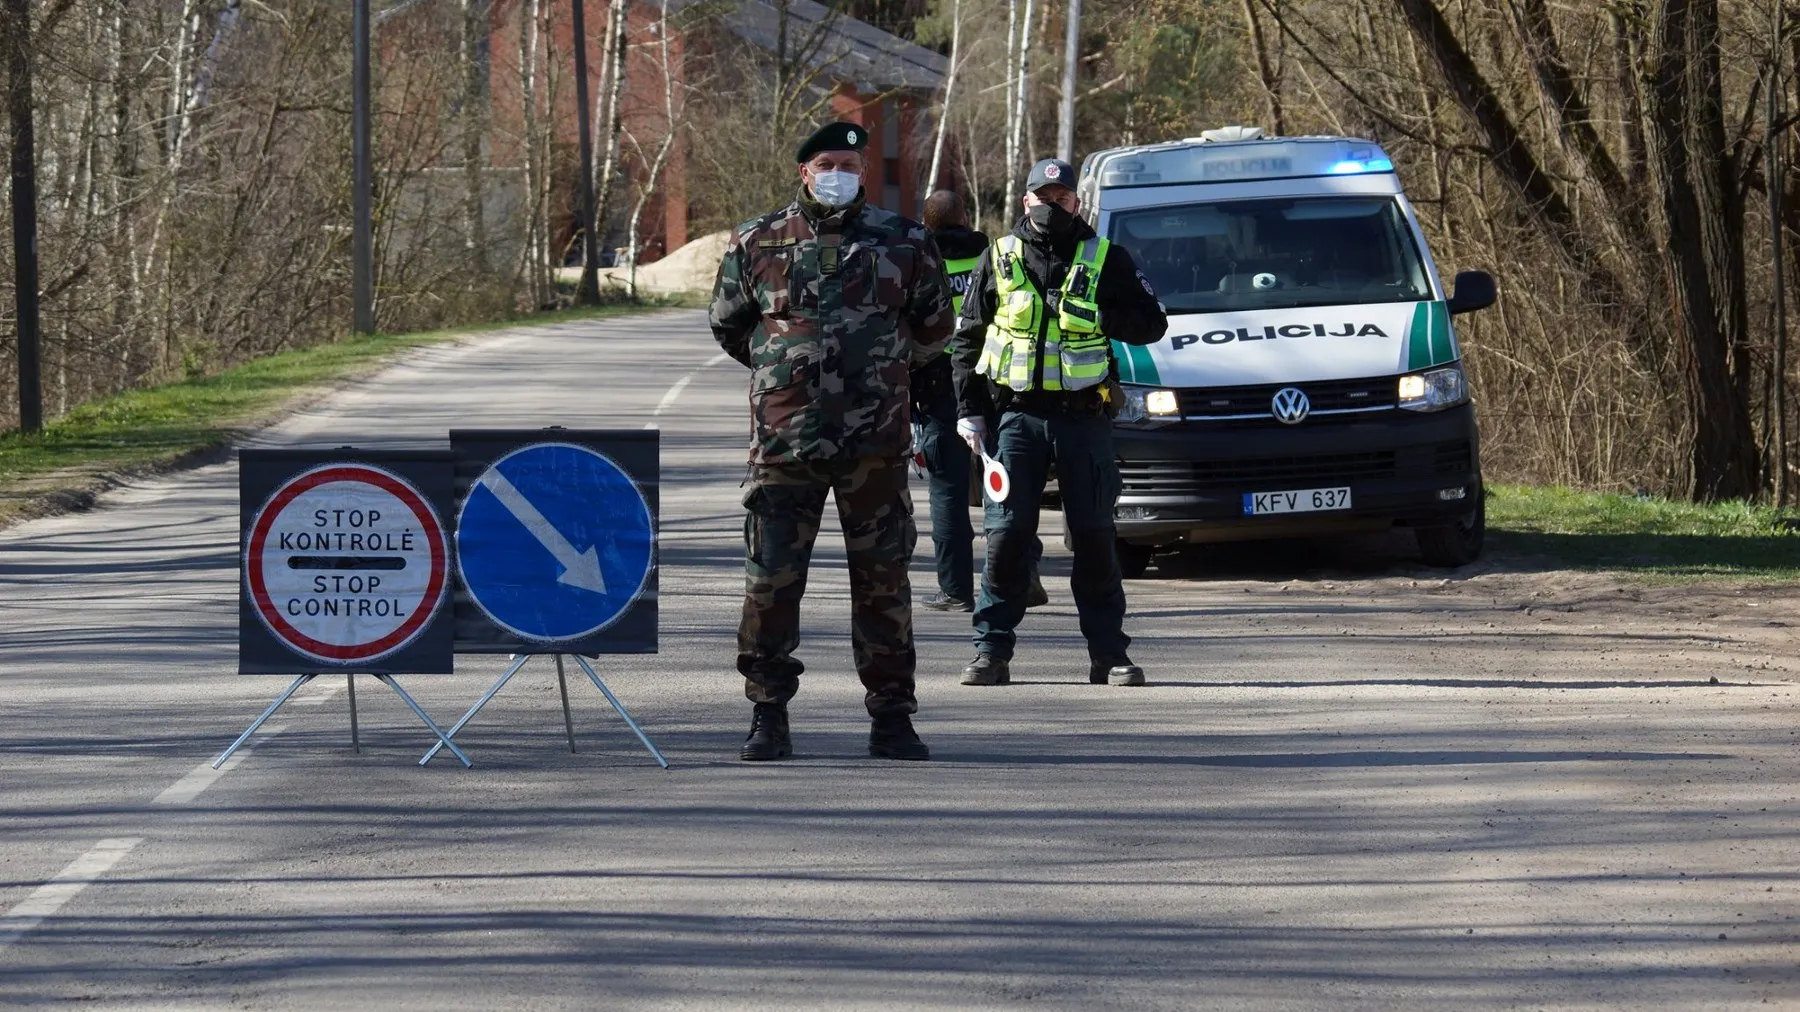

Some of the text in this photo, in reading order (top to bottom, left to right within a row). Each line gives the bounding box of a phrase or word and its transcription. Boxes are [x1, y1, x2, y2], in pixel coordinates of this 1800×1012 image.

[1170, 323, 1389, 351] POLICIJA
[1255, 489, 1348, 512] KFV 637
[314, 509, 381, 527] STOP
[280, 528, 414, 551] KONTROLĖ
[313, 575, 381, 593] STOP
[287, 598, 405, 617] CONTROL
